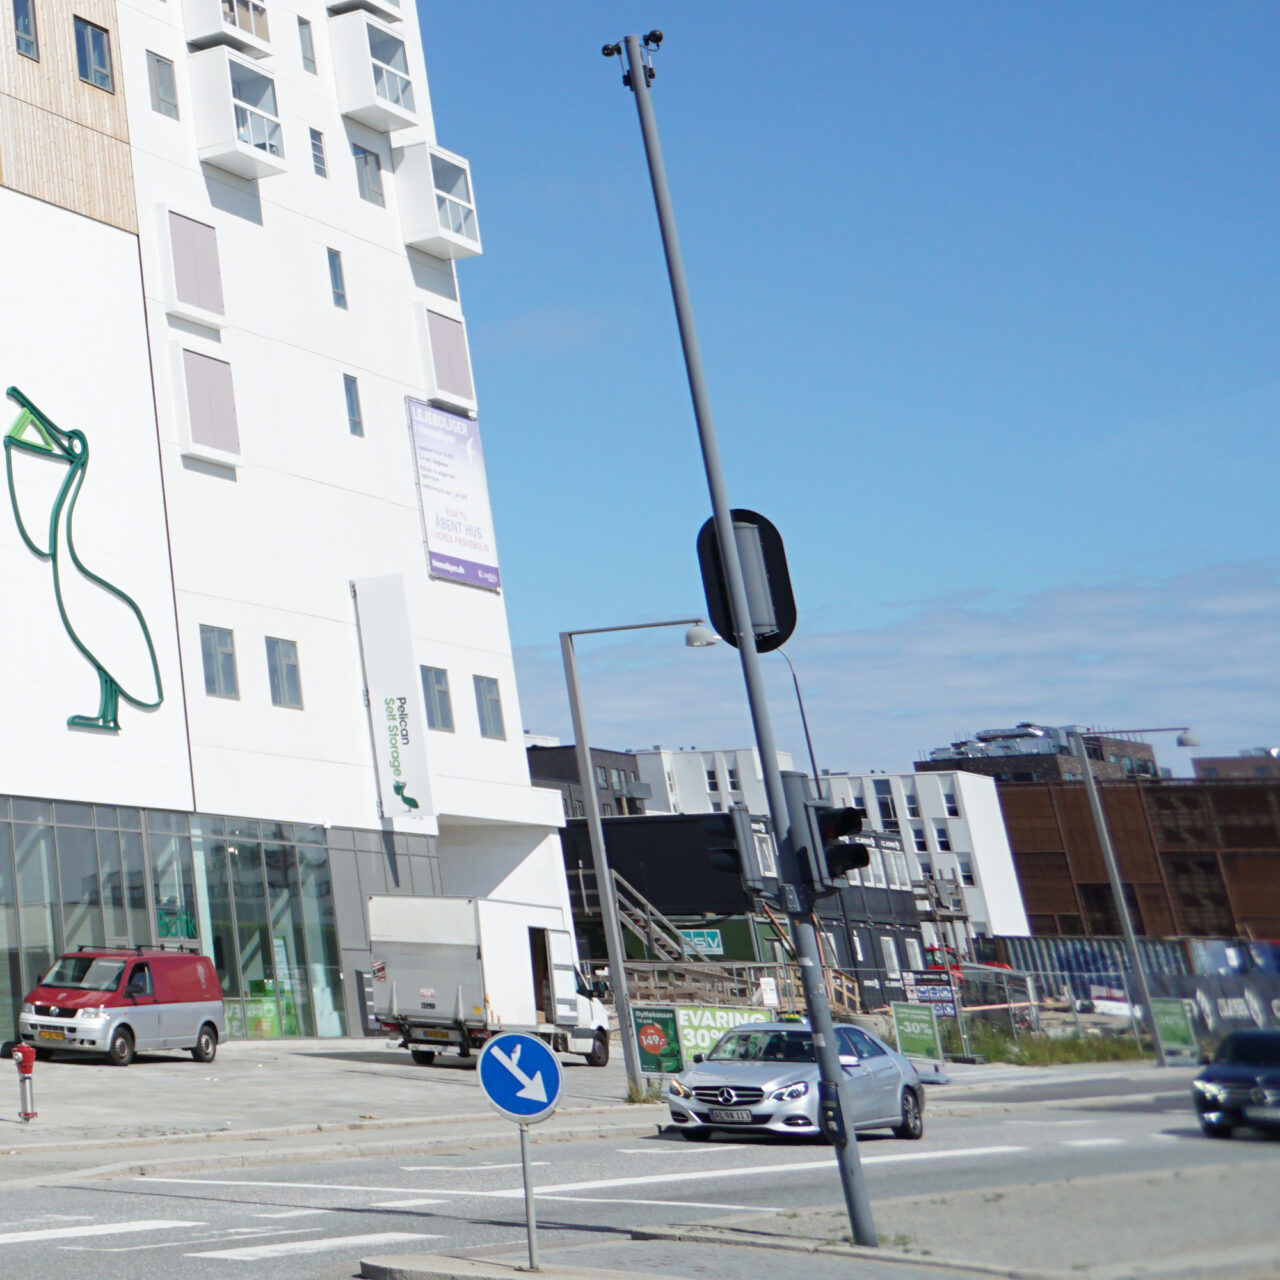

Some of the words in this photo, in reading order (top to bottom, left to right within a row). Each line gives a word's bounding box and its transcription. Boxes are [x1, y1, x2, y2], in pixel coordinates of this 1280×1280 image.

[411, 405, 469, 436] LEJEBOLIGER
[465, 524, 482, 540] HUS
[385, 698, 397, 721] Self
[396, 696, 410, 746] Pelican
[388, 724, 402, 777] Storage
[156, 909, 197, 938] Butik
[899, 1021, 933, 1035] -30%
